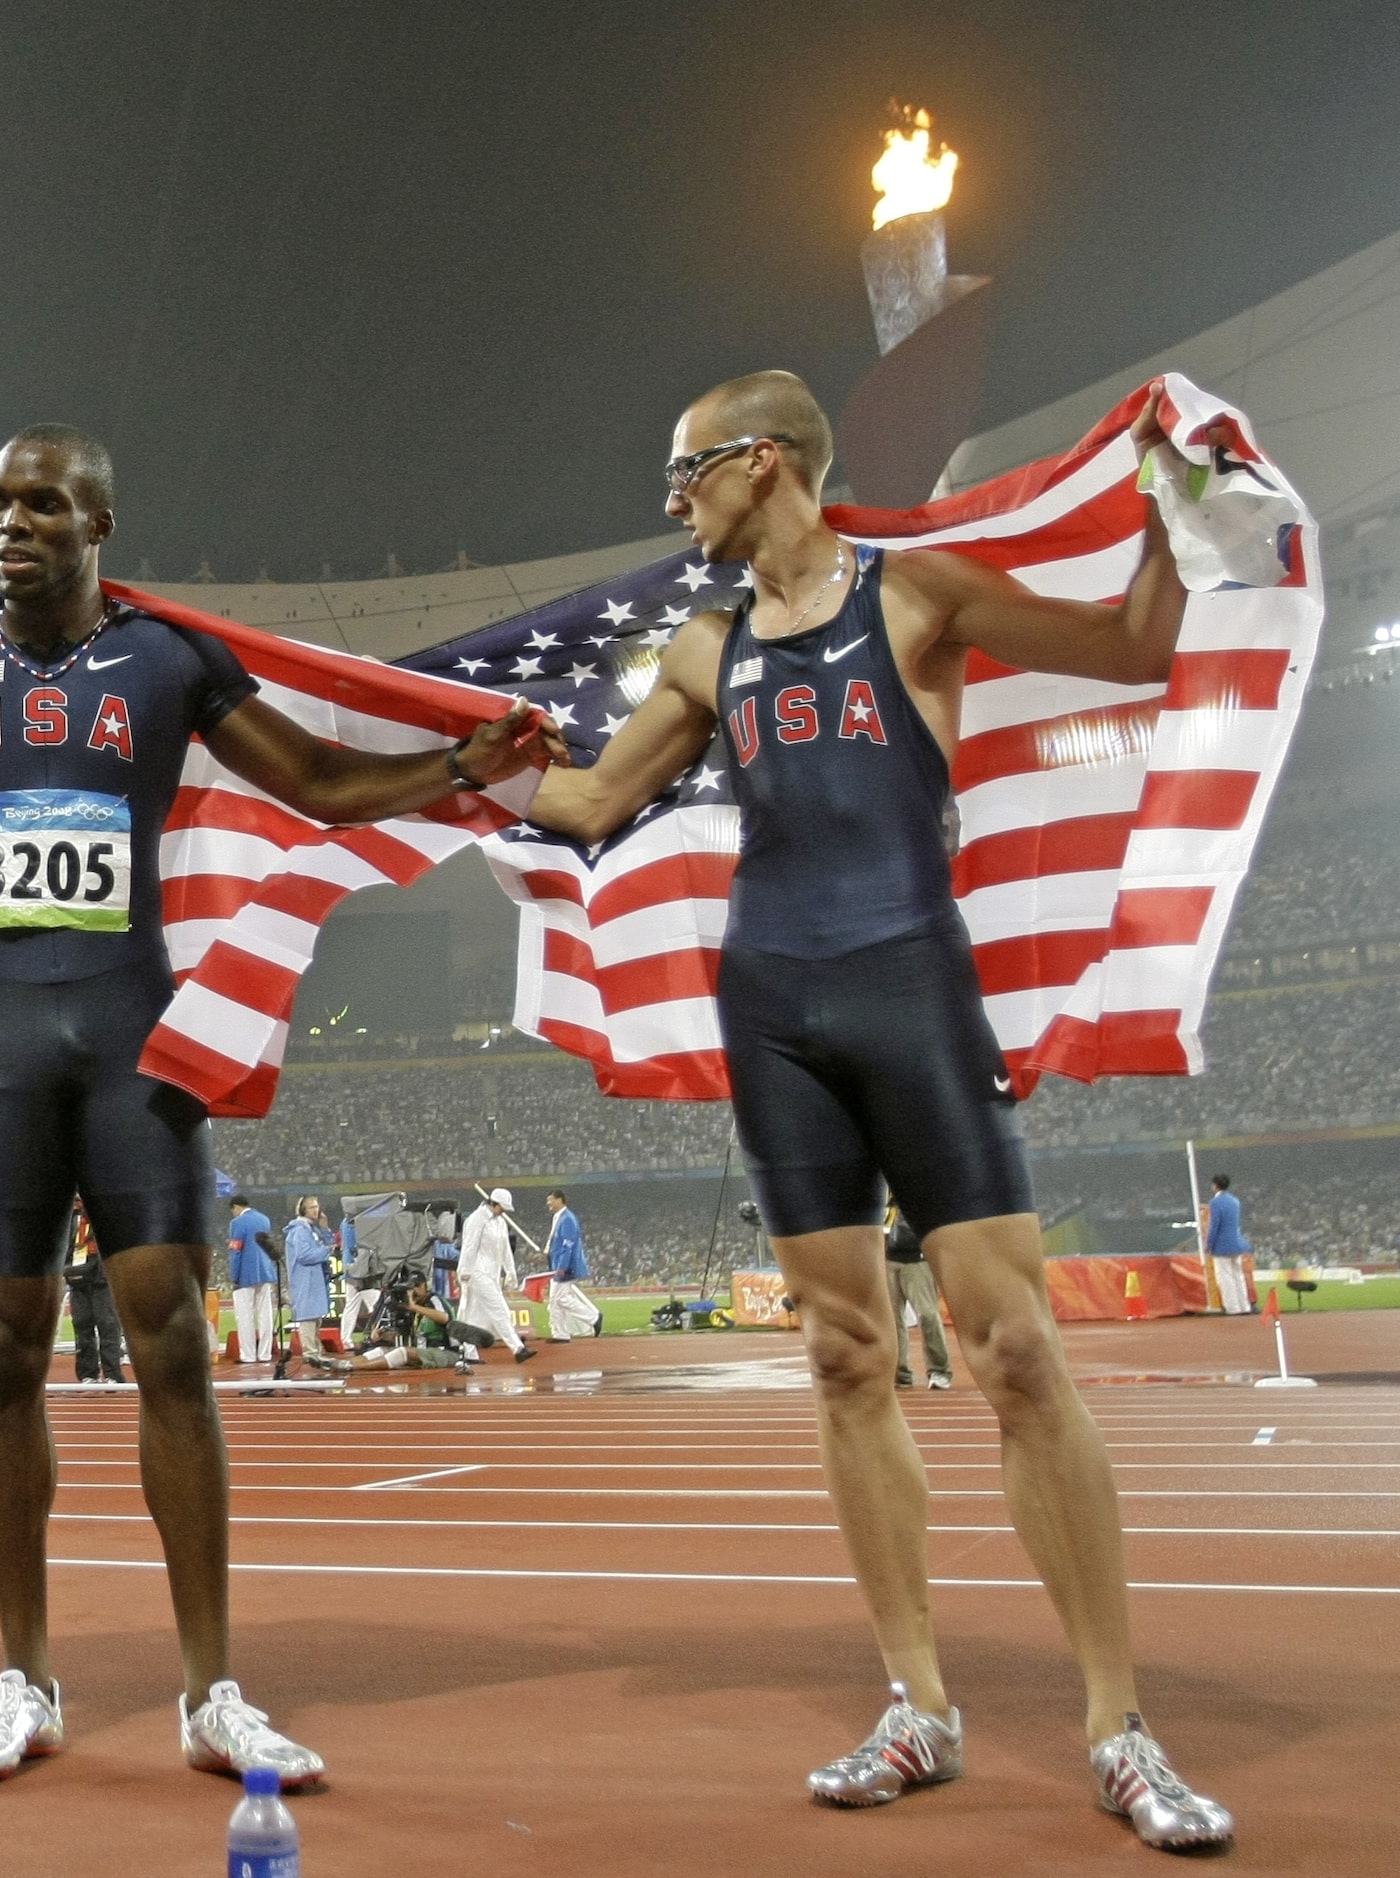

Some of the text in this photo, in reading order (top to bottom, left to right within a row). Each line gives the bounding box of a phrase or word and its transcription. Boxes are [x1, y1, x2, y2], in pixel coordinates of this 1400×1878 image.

[728, 679, 888, 769] USA
[2, 804, 73, 821] Beijing 2008
